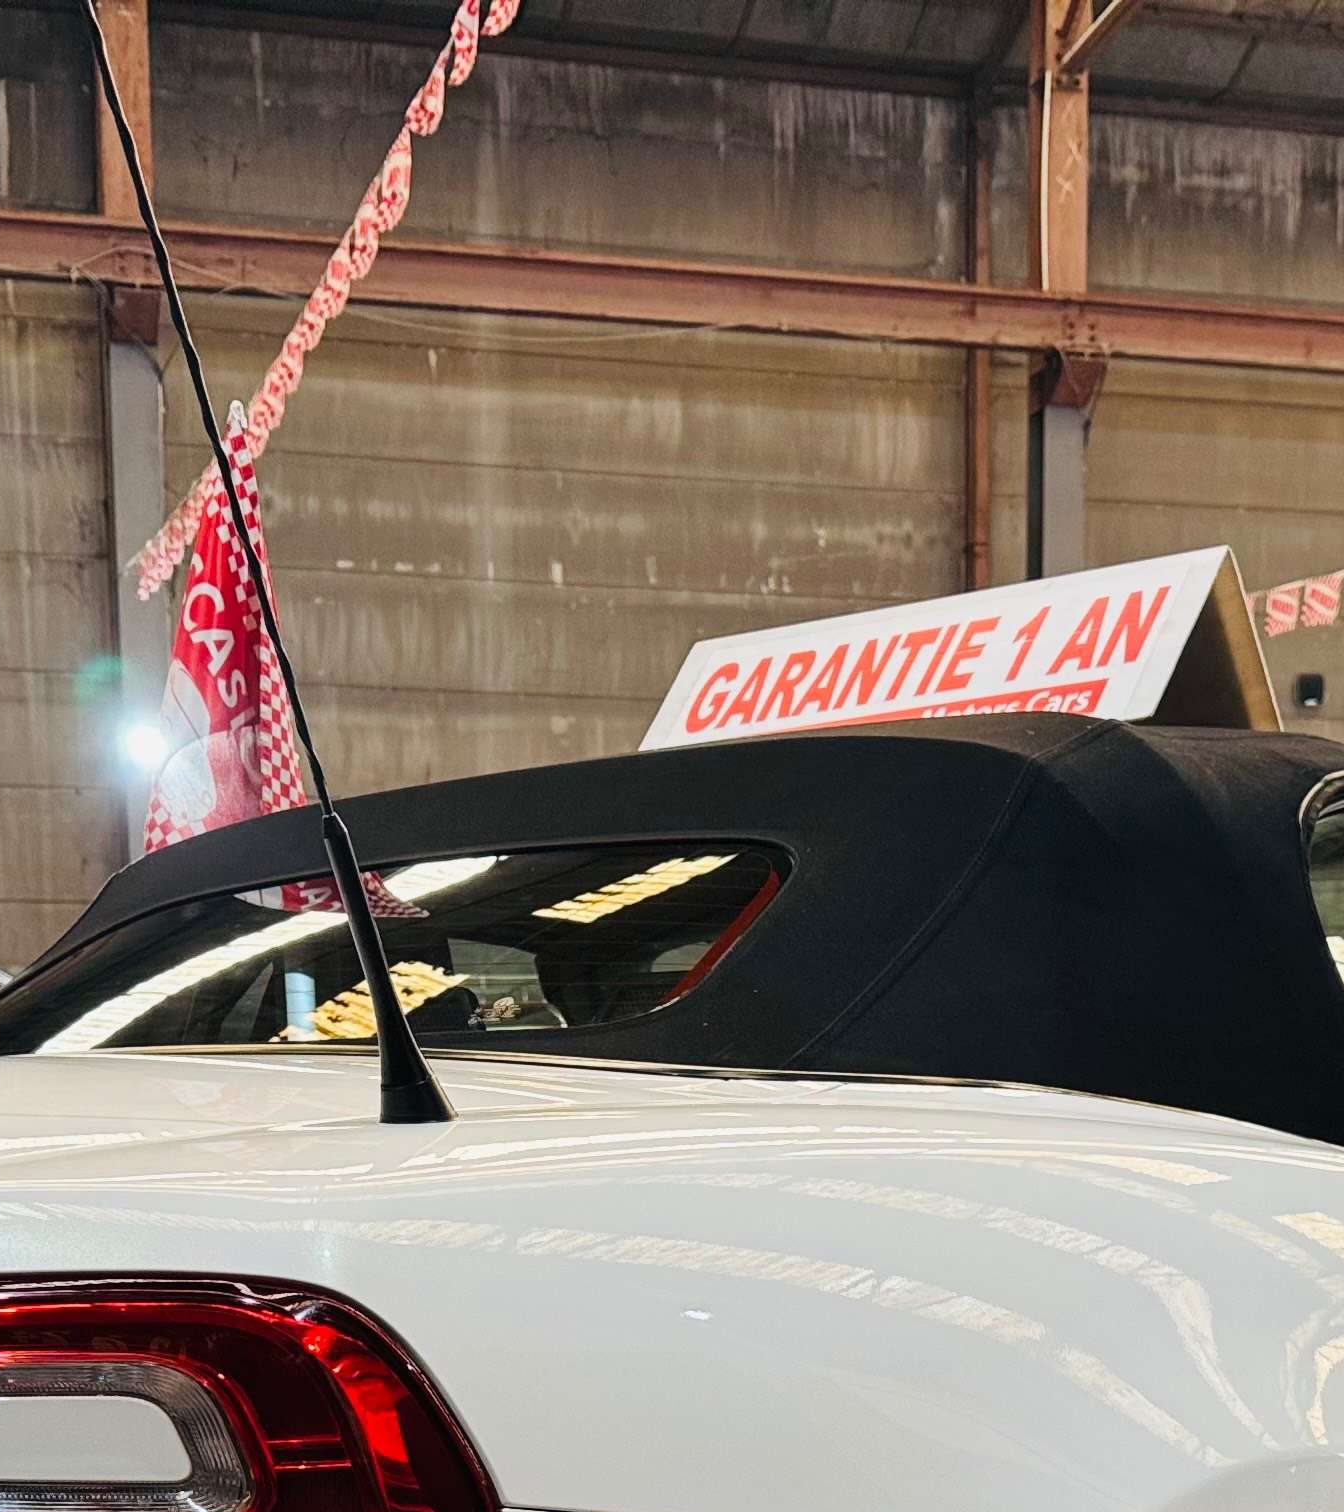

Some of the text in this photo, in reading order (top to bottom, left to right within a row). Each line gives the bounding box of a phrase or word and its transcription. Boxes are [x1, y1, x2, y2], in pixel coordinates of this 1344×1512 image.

[684, 585, 1172, 734] GARANTIE 1 AN
[1024, 690, 1093, 713] Cars
